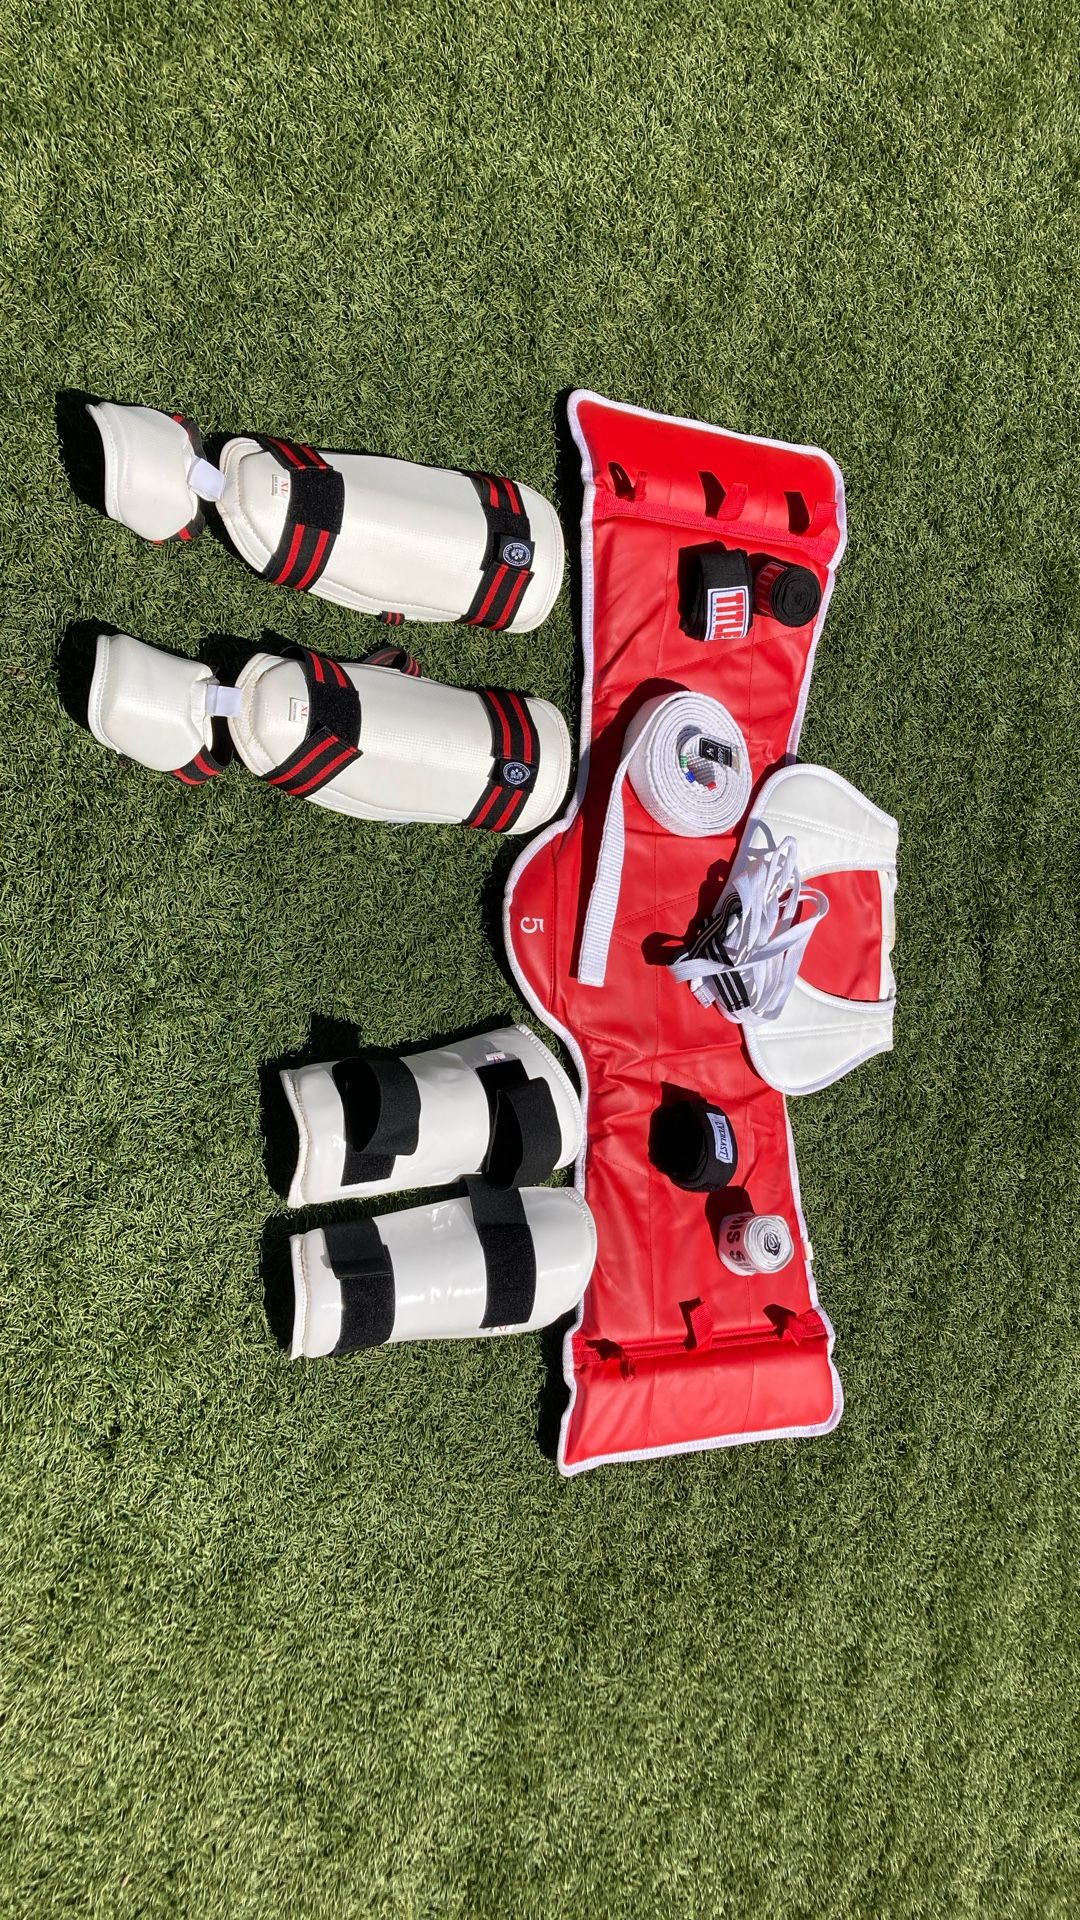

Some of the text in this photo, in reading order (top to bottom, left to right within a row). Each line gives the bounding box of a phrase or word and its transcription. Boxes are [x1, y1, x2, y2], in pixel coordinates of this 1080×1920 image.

[714, 592, 744, 639] TITLE
[300, 705, 308, 720] XL
[520, 917, 544, 934] 5
[716, 1121, 729, 1157] EVERLAST
